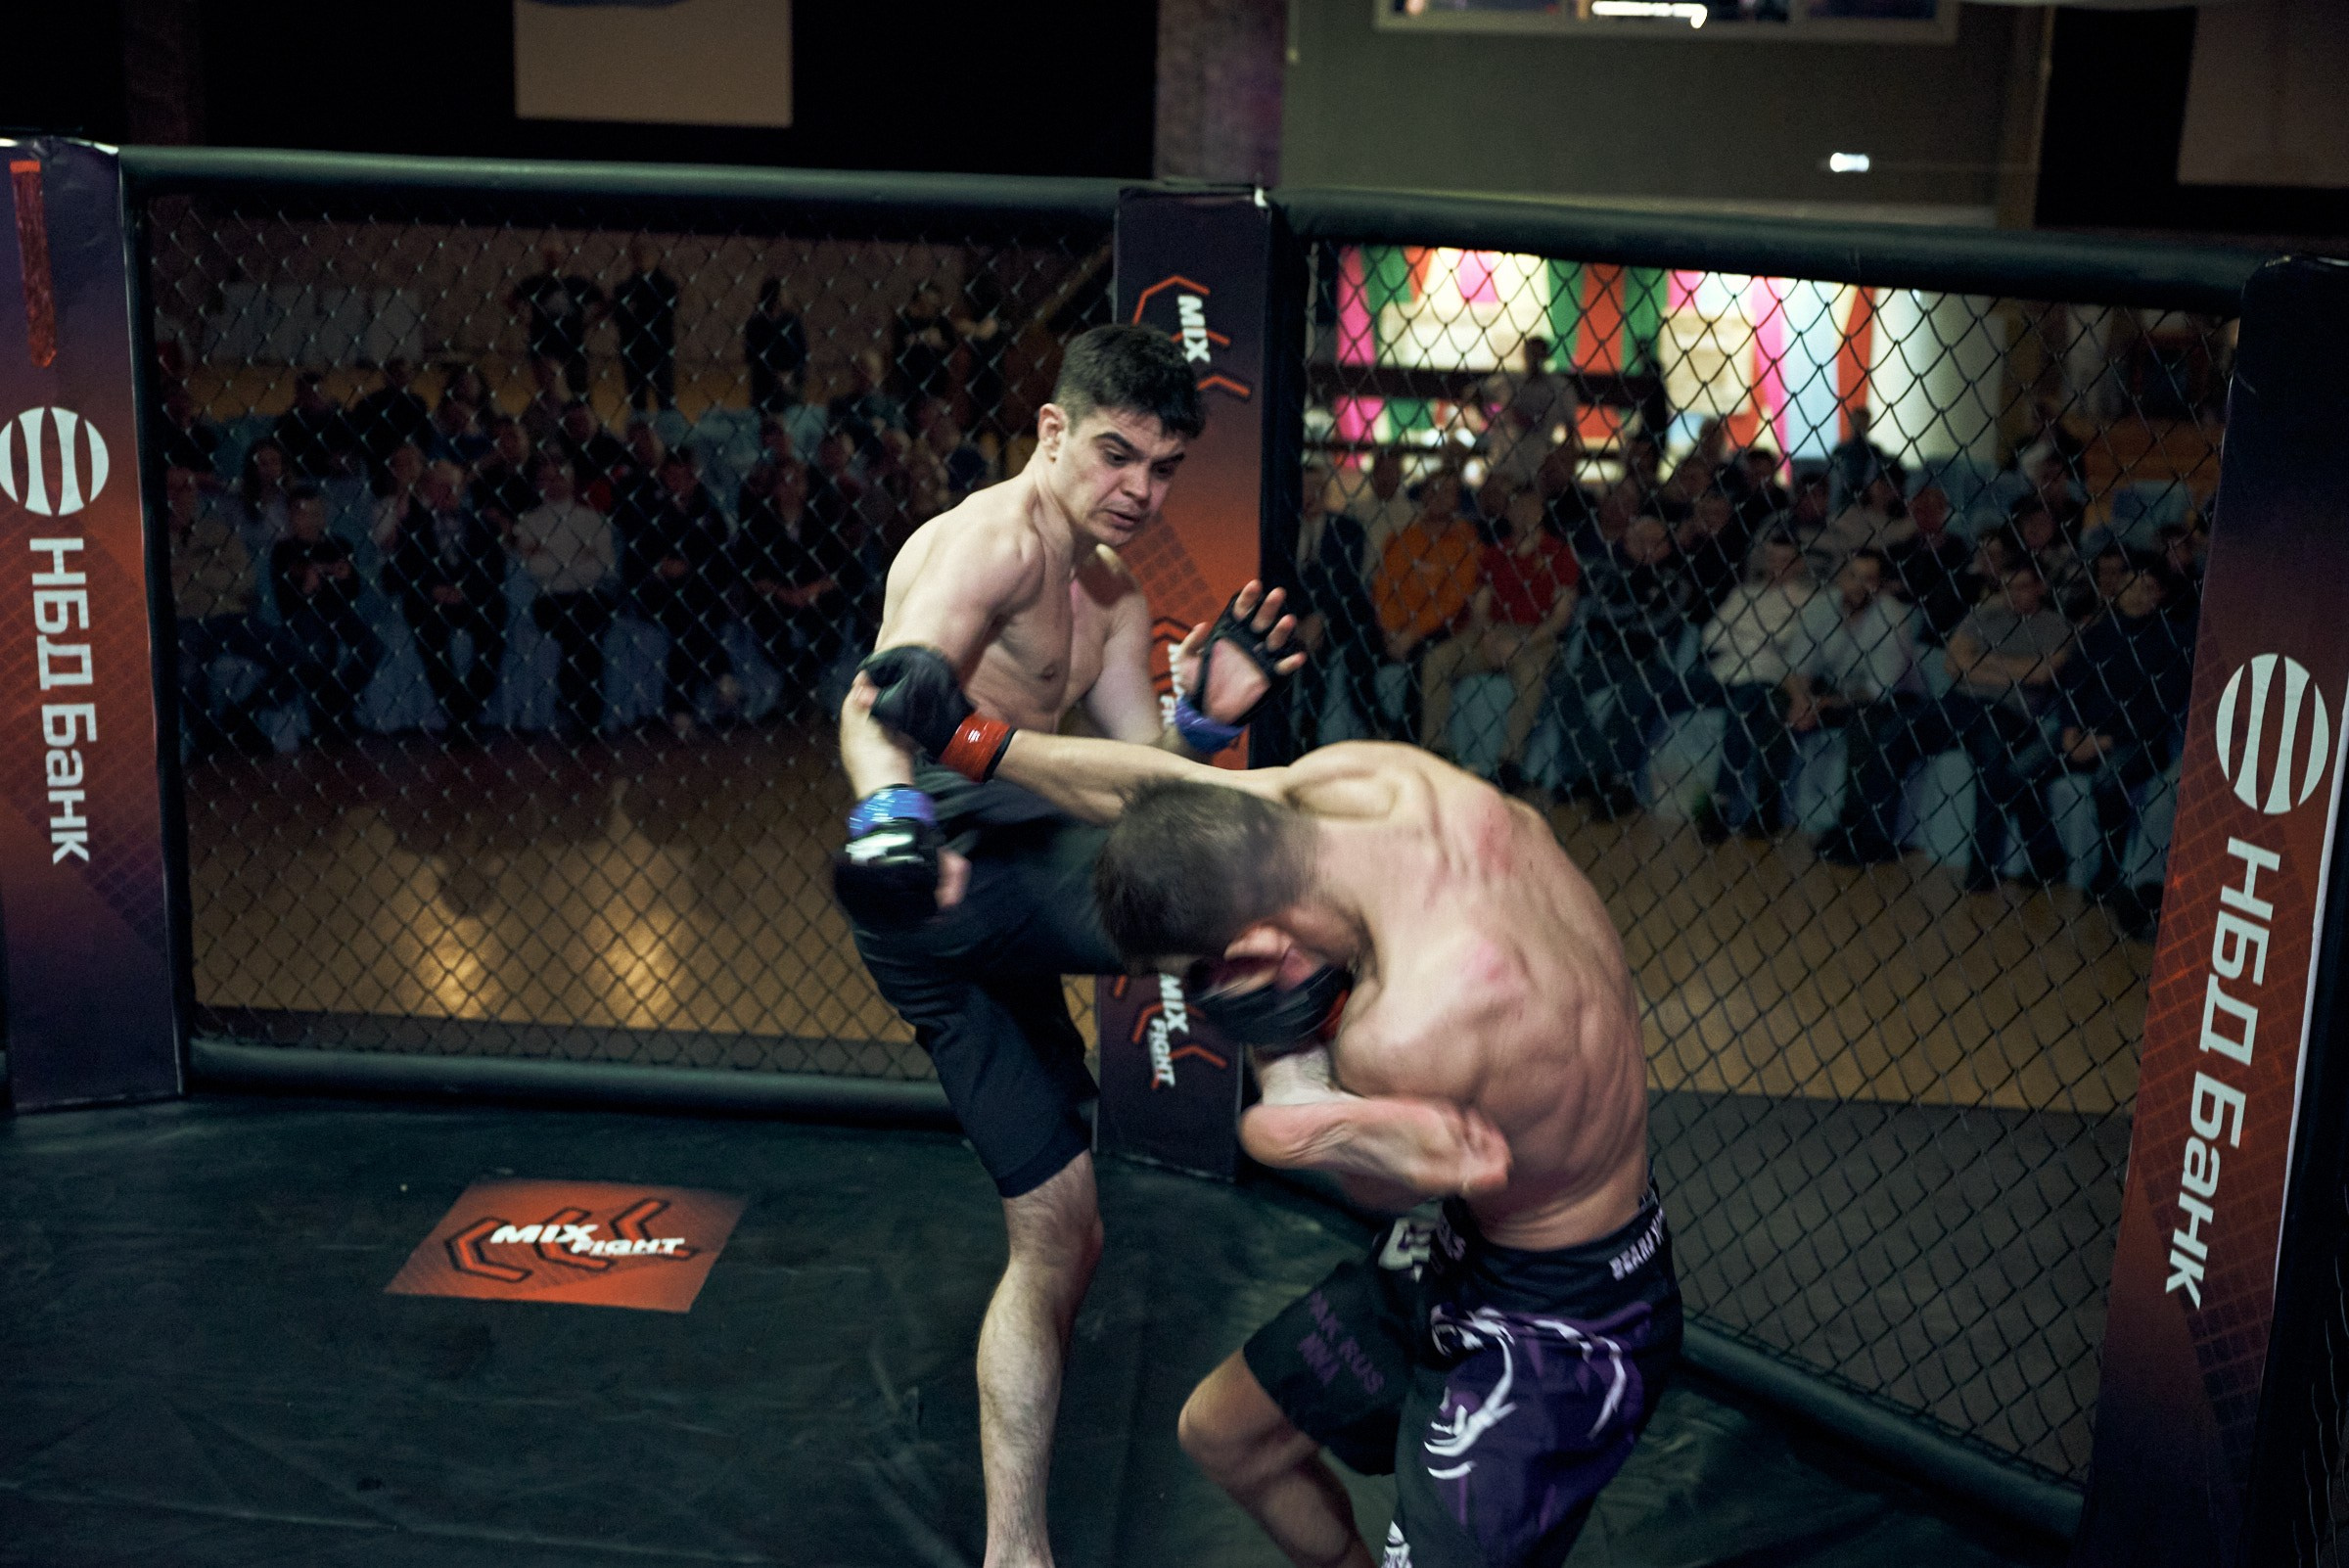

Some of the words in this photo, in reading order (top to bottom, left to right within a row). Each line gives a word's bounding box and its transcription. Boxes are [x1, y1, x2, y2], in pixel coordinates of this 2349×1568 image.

[1177, 295, 1211, 363] MIX
[28, 537, 93, 691] НБД
[41, 702, 98, 864] Банк
[2198, 836, 2281, 1067] НБД
[1159, 973, 1189, 1036] MIX
[1148, 1017, 1175, 1088] FIGHT
[2165, 1071, 2247, 1310] Банк
[490, 1223, 599, 1244] MIX
[569, 1237, 686, 1257] FIGHT
